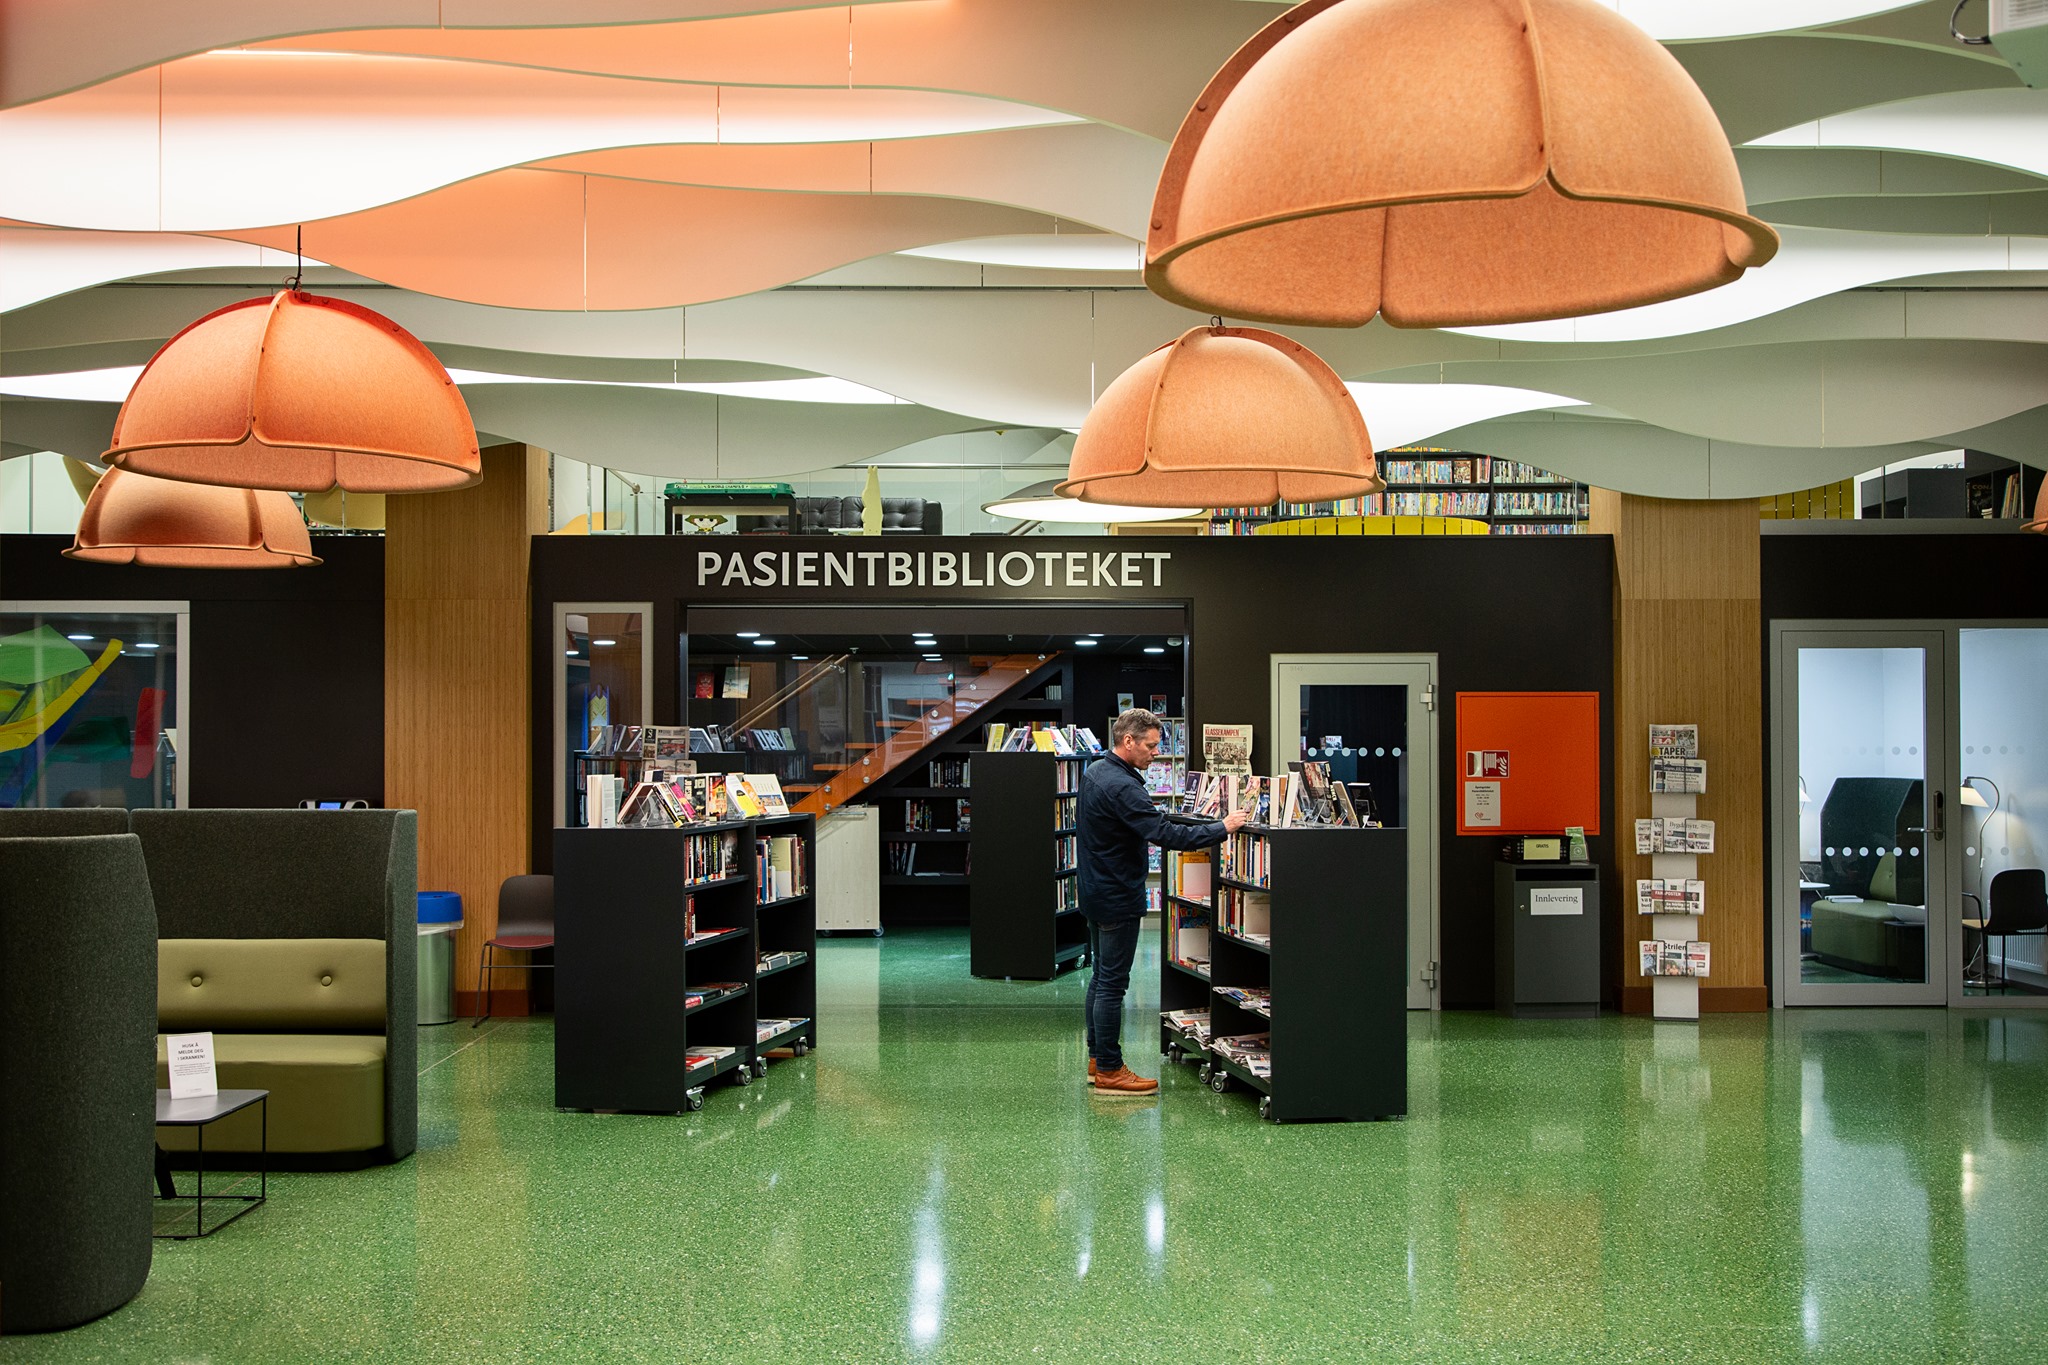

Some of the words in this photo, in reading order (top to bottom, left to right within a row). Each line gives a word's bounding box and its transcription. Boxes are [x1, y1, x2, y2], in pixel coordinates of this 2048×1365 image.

[698, 551, 1161, 586] PASIENTBIBLIOTEKET
[1204, 728, 1240, 736] KLASSEKAMPEN
[1659, 747, 1686, 755] TAPER
[1535, 894, 1579, 904] Innlevering
